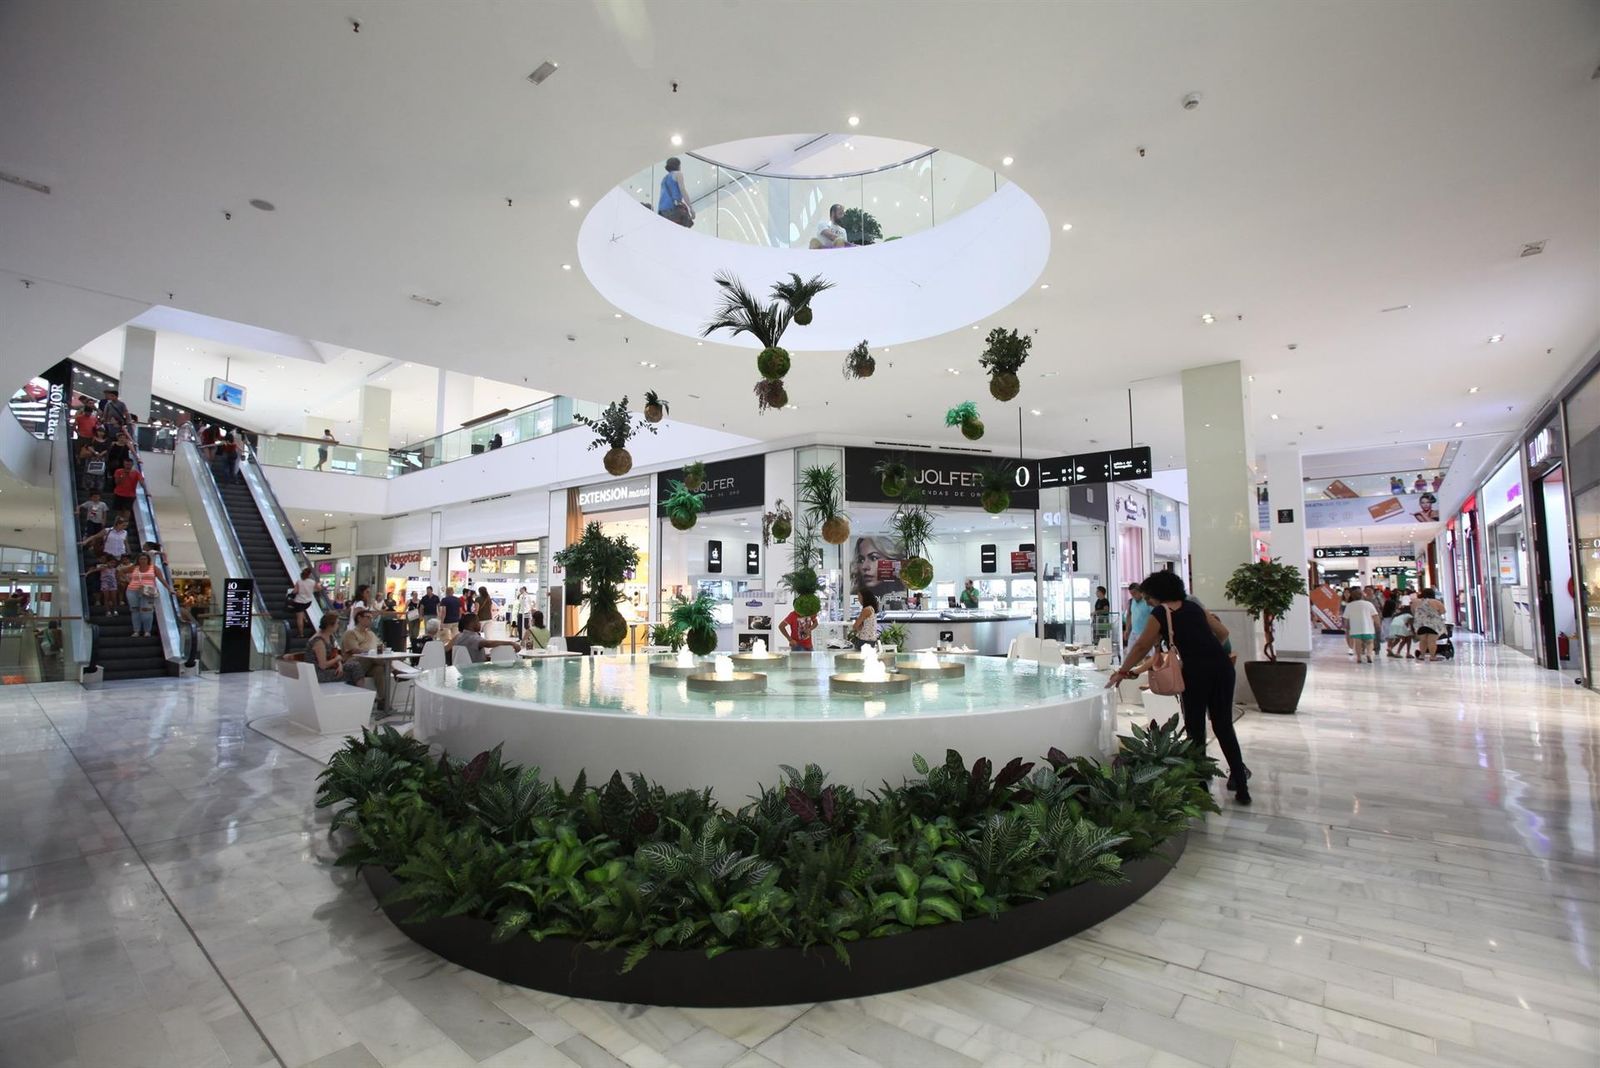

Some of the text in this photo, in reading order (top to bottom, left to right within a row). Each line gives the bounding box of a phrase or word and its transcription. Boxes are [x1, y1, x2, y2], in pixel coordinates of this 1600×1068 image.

[914, 469, 984, 487] JOLFER
[1015, 466, 1030, 488] 0
[579, 486, 628, 506] EXTENSION
